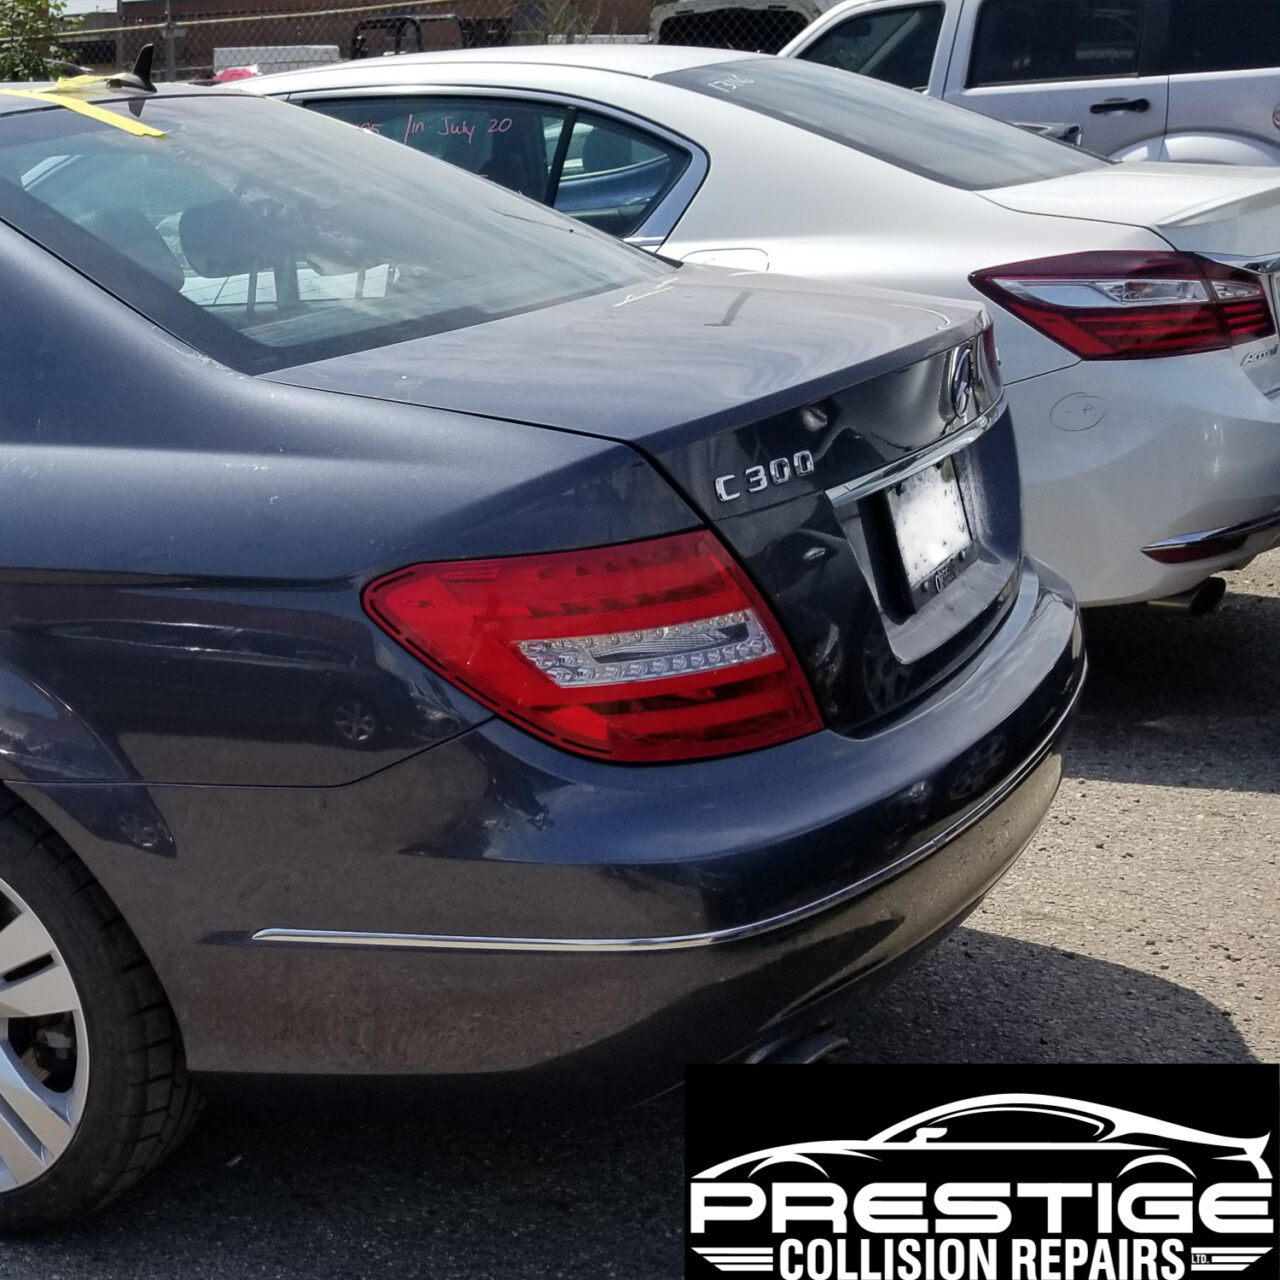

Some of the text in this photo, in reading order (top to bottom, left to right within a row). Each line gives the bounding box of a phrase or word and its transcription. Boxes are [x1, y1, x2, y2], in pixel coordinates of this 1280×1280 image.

[437, 116, 476, 143] July
[487, 118, 513, 133] 20
[715, 450, 815, 502] C 300
